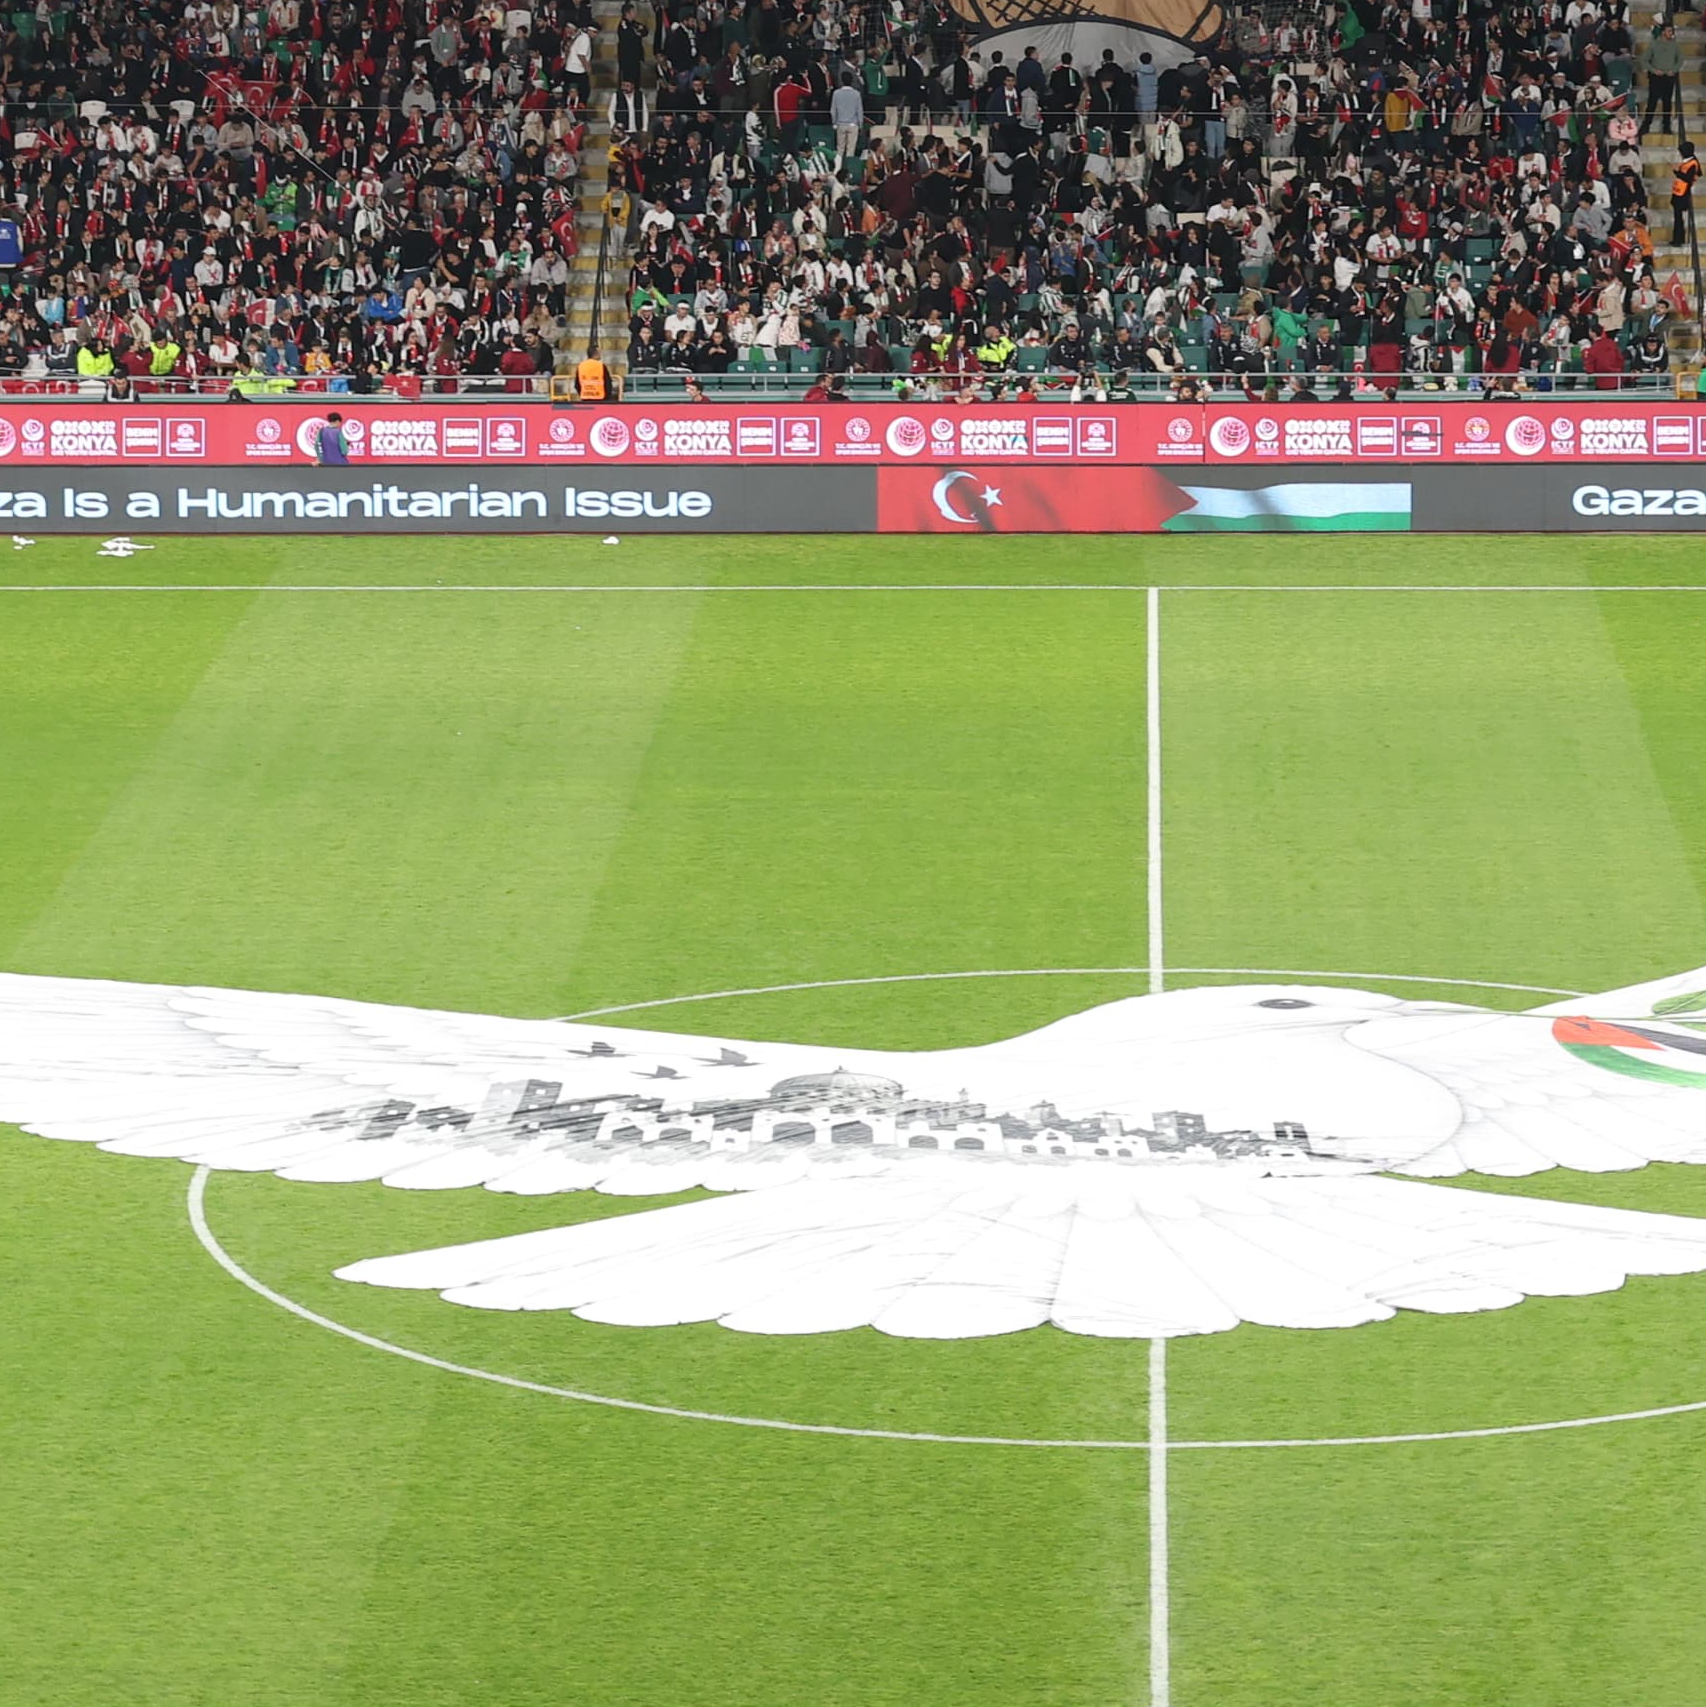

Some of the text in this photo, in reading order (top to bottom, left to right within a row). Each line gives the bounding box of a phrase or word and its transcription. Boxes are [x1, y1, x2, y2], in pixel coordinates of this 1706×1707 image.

[50, 434, 118, 450] KONYA
[370, 434, 438, 450] KONYA
[664, 434, 732, 450] KONYA
[960, 433, 1028, 449] KONYA
[1285, 433, 1353, 449] KONYA
[1581, 433, 1649, 449] KONYA
[63, 487, 109, 518] Is
[126, 491, 160, 518] a
[177, 483, 547, 518] Humanitarian
[565, 487, 712, 518] Issue
